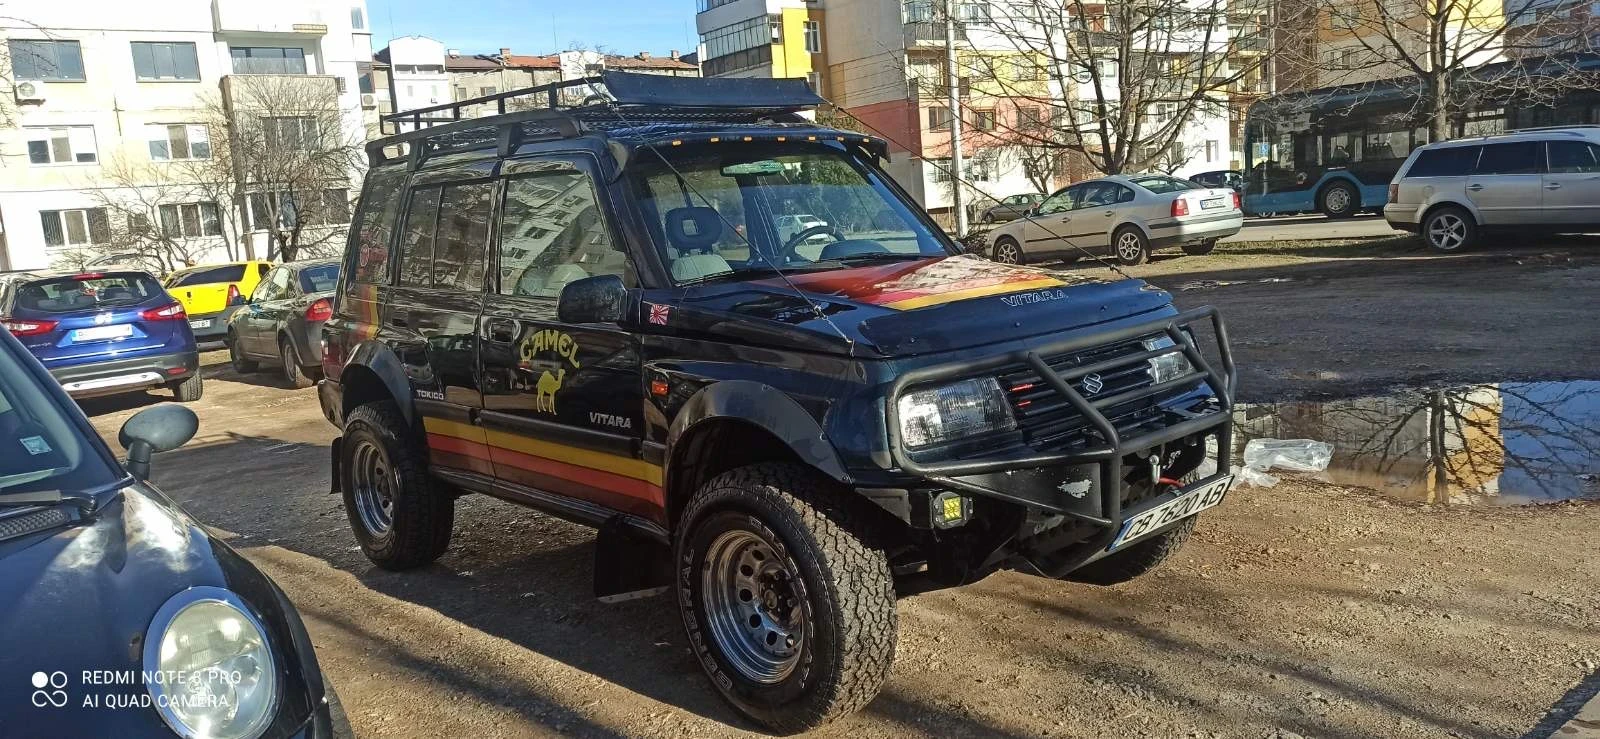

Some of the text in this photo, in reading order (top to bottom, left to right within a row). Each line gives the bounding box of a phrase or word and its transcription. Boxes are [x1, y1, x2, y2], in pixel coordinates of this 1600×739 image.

[1000, 290, 1068, 307] VITARA
[520, 329, 580, 369] CAMEL
[416, 389, 444, 400] TOKICO
[589, 412, 632, 429] VITARA
[1123, 482, 1226, 538] CB 7620 AB
[679, 548, 733, 690] GENERAL
